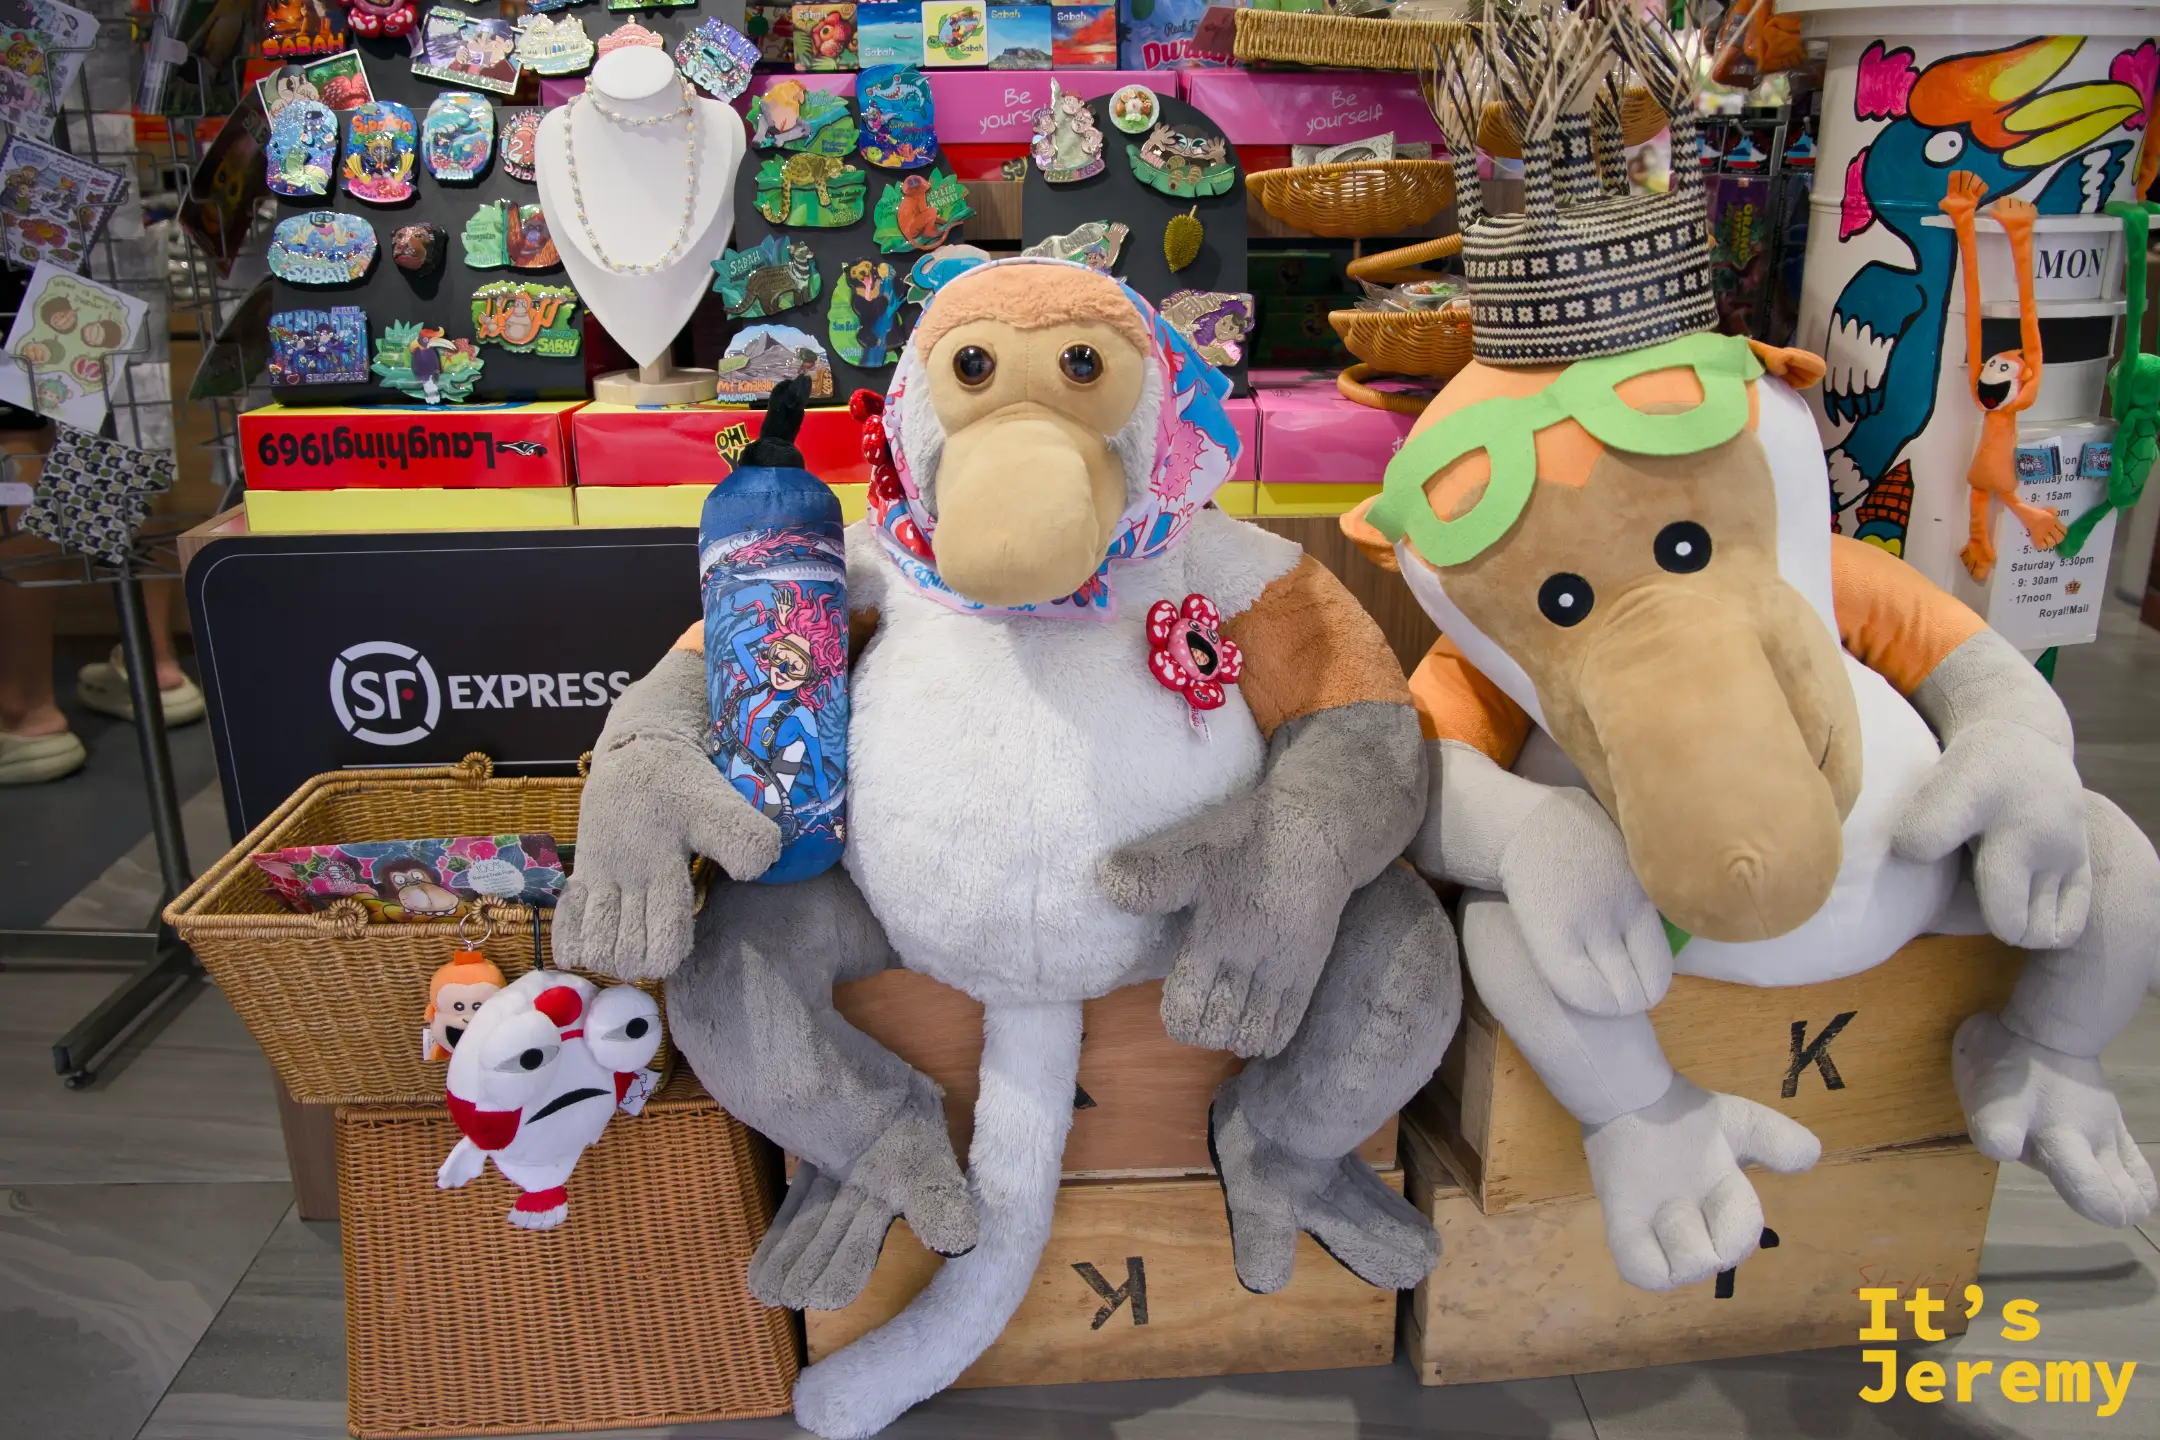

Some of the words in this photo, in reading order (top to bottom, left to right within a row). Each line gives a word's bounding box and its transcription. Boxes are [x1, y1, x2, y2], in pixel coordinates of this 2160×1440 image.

[797, 9, 827, 20] Sabah
[991, 9, 1021, 19] Sabah
[1057, 11, 1087, 21] Sabah
[1164, 18, 1187, 37] Real
[262, 31, 345, 60] SABAH
[864, 47, 895, 57] Sabah
[960, 44, 984, 52] Sabah
[1004, 88, 1032, 108] Be
[1331, 90, 1358, 109] Be
[1306, 104, 1384, 136] yourself
[729, 250, 761, 276] SABAH
[2035, 248, 2105, 279] MON
[287, 264, 352, 284] SABAH
[717, 392, 758, 402] MALAYSIA
[716, 423, 750, 450] OH!
[258, 426, 496, 469] Laughing1969
[2046, 491, 2072, 502] 15am
[2011, 560, 2056, 573] Saturday
[2059, 555, 2095, 568] 5:30pm
[2032, 575, 2059, 587] 30am
[2015, 592, 2053, 604] 17noon
[448, 671, 631, 710] EXPRESS
[1780, 1010, 1859, 1099] K
[1070, 1256, 1150, 1331] K
